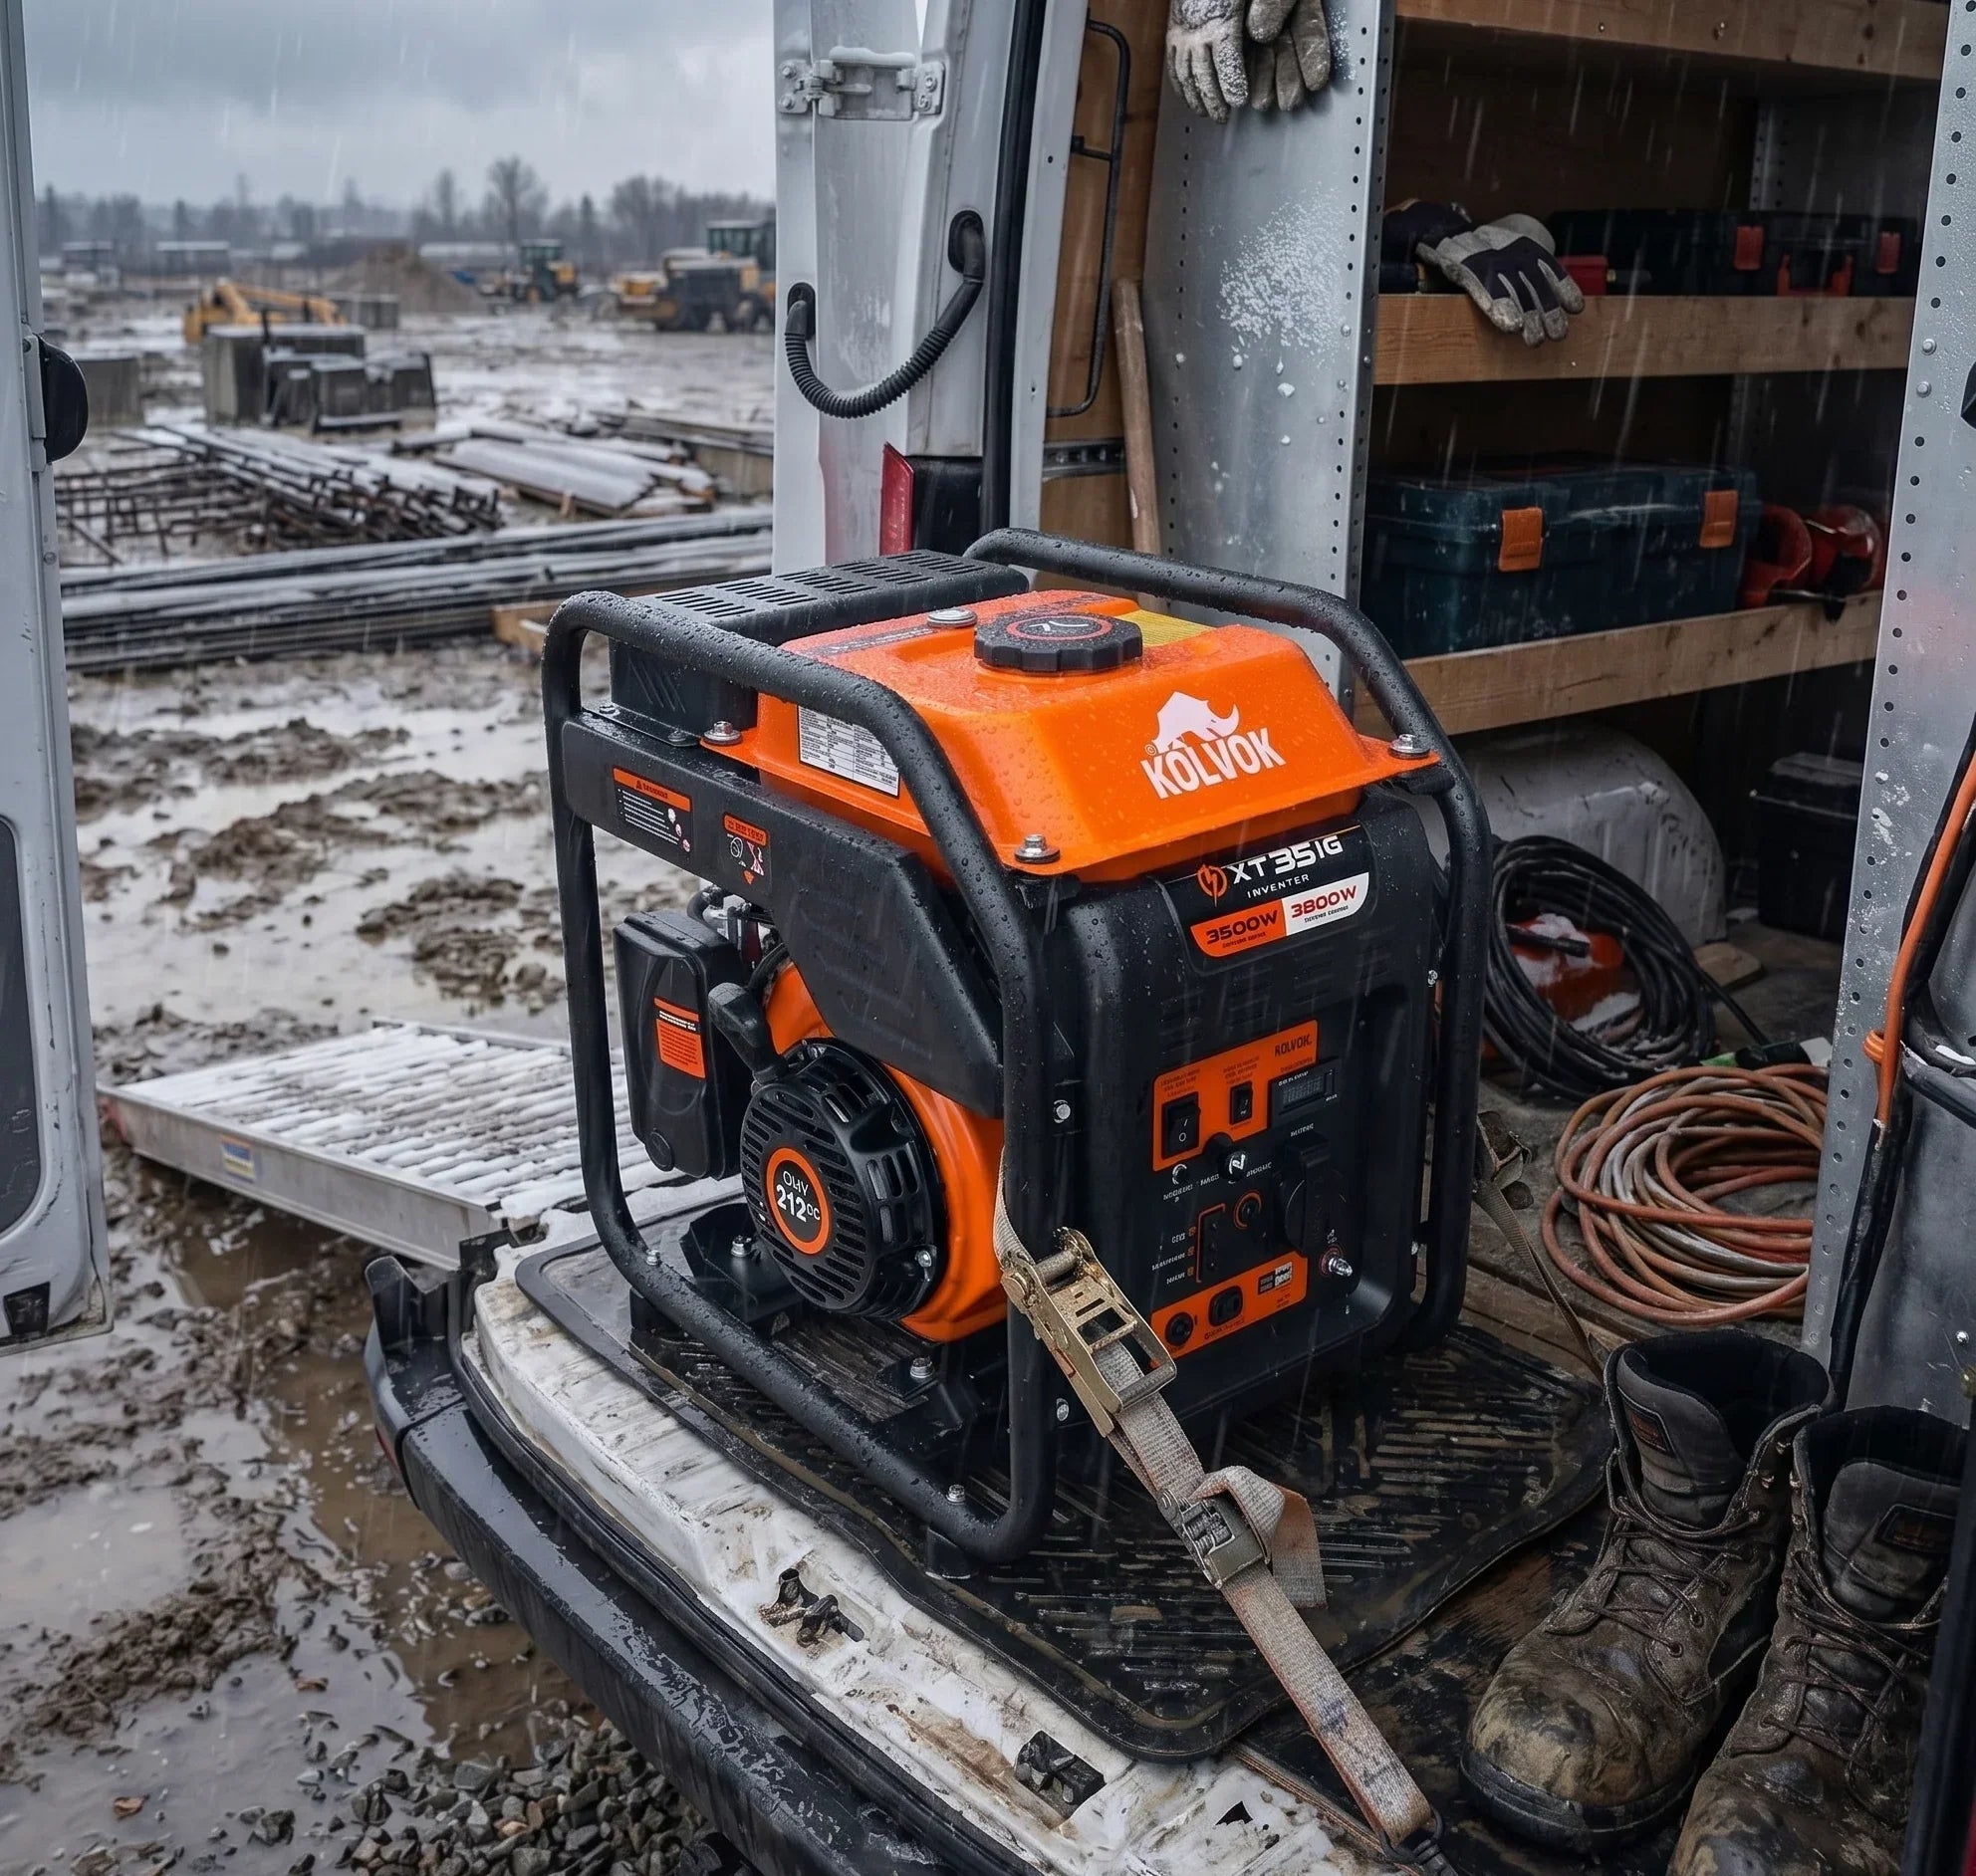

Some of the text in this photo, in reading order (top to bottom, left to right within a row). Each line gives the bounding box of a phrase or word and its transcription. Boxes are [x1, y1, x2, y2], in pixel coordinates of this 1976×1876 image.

[1140, 728, 1287, 799] KOLVOK
[1206, 909, 1278, 945] 3500W
[1291, 885, 1358, 918] 3800W
[1247, 873, 1310, 899] INVENTER
